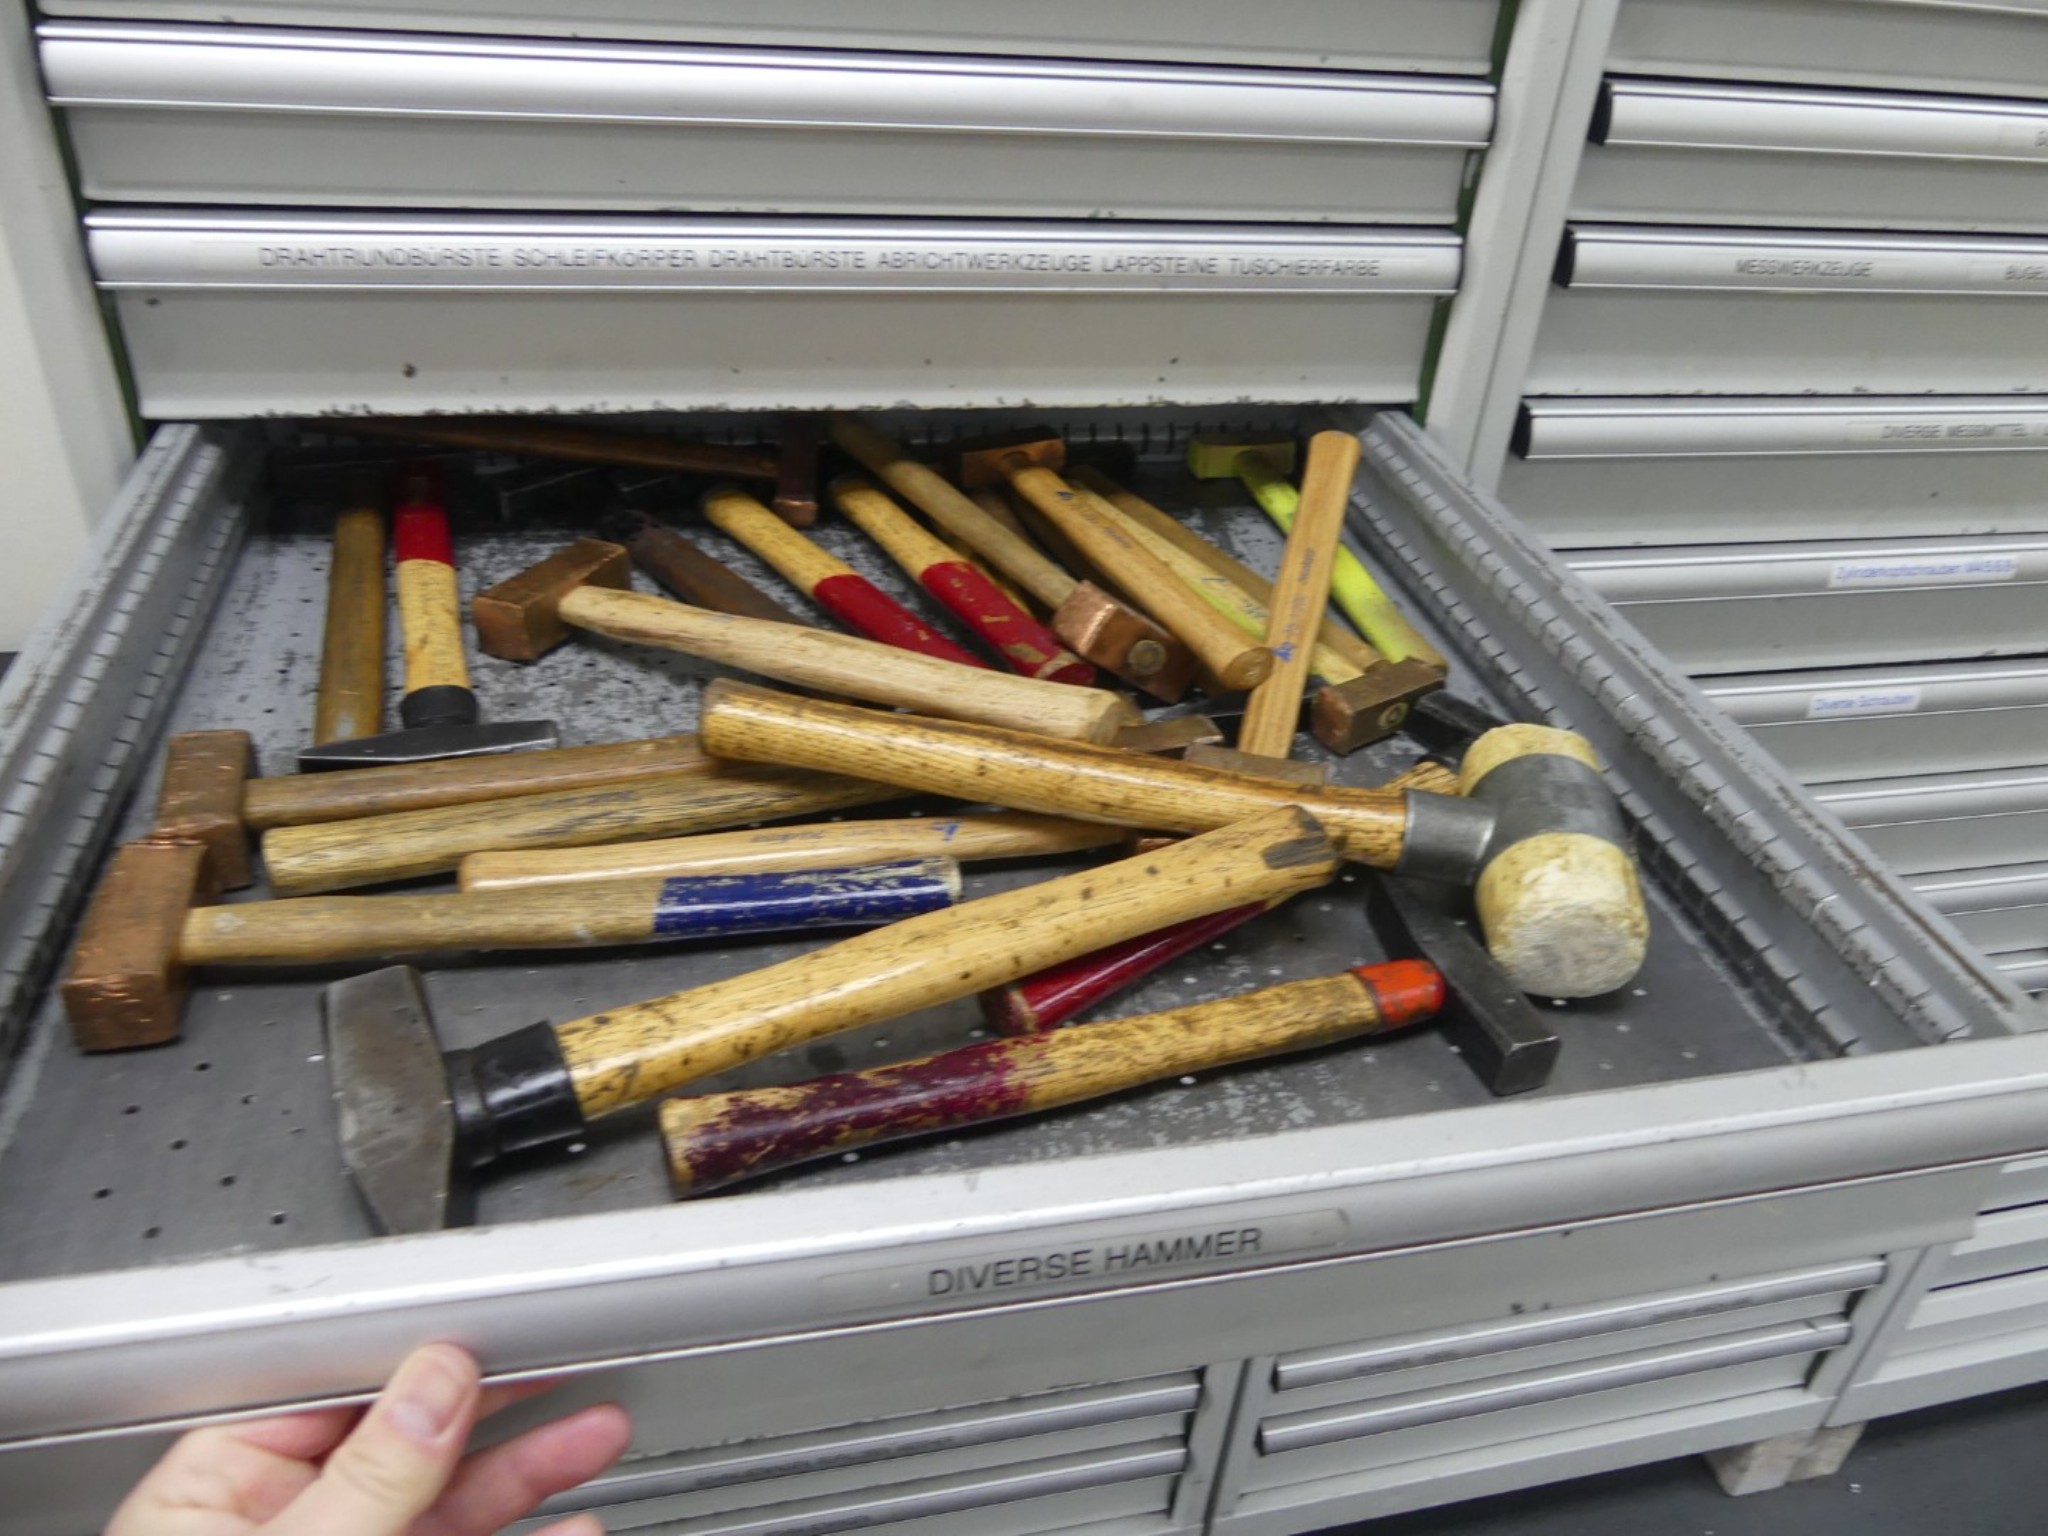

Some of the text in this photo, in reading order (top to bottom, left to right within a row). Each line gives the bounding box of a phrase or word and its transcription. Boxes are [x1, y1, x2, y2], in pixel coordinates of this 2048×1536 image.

[513, 248, 697, 268] SCHLEIFKÖRPER
[708, 249, 866, 269] DRAHTBÜRSTE
[877, 251, 1092, 273] ABRICHTWERKZEUGE
[1229, 257, 1381, 277] TUSCHIERFARBE
[928, 1249, 1094, 1297] DIVERSE
